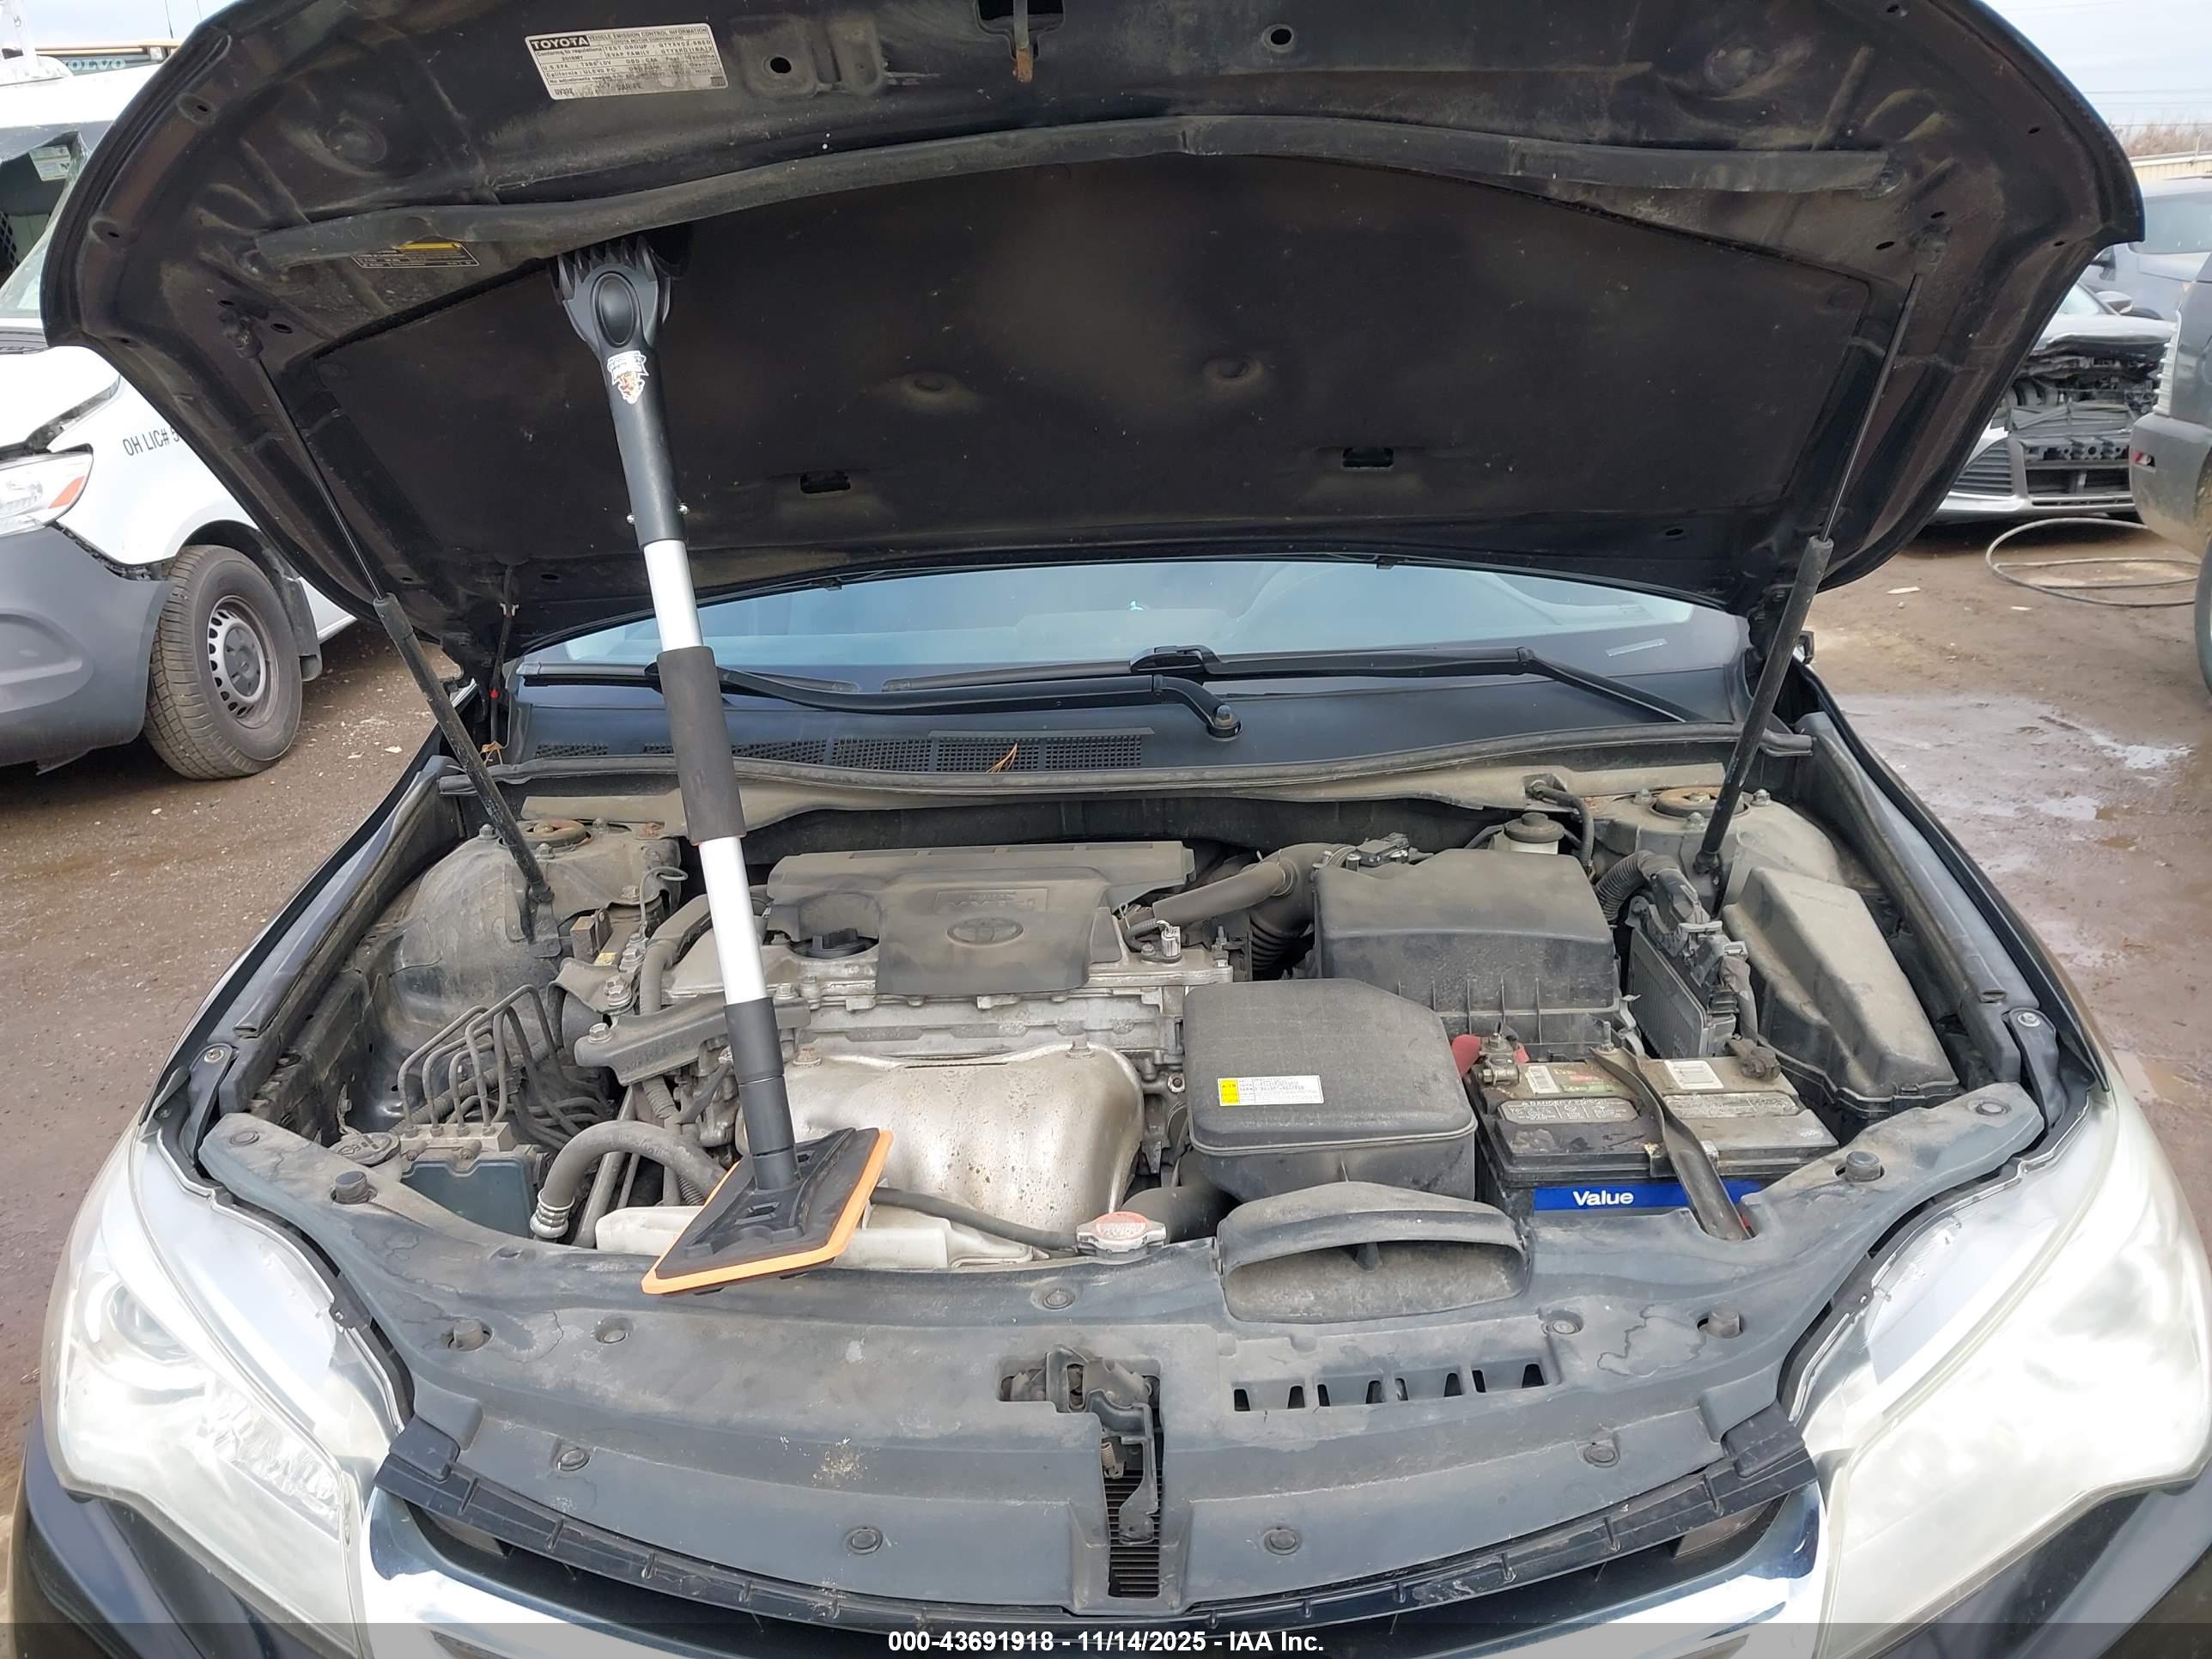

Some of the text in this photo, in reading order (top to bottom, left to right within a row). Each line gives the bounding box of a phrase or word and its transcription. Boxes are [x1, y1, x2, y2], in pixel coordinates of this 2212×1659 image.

[531, 37, 589, 50] TOYOTA
[67, 58, 125, 70] OLVO
[123, 435, 143, 456] OH
[142, 428, 171, 451] LIC#
[1572, 1189, 1634, 1206] Value
